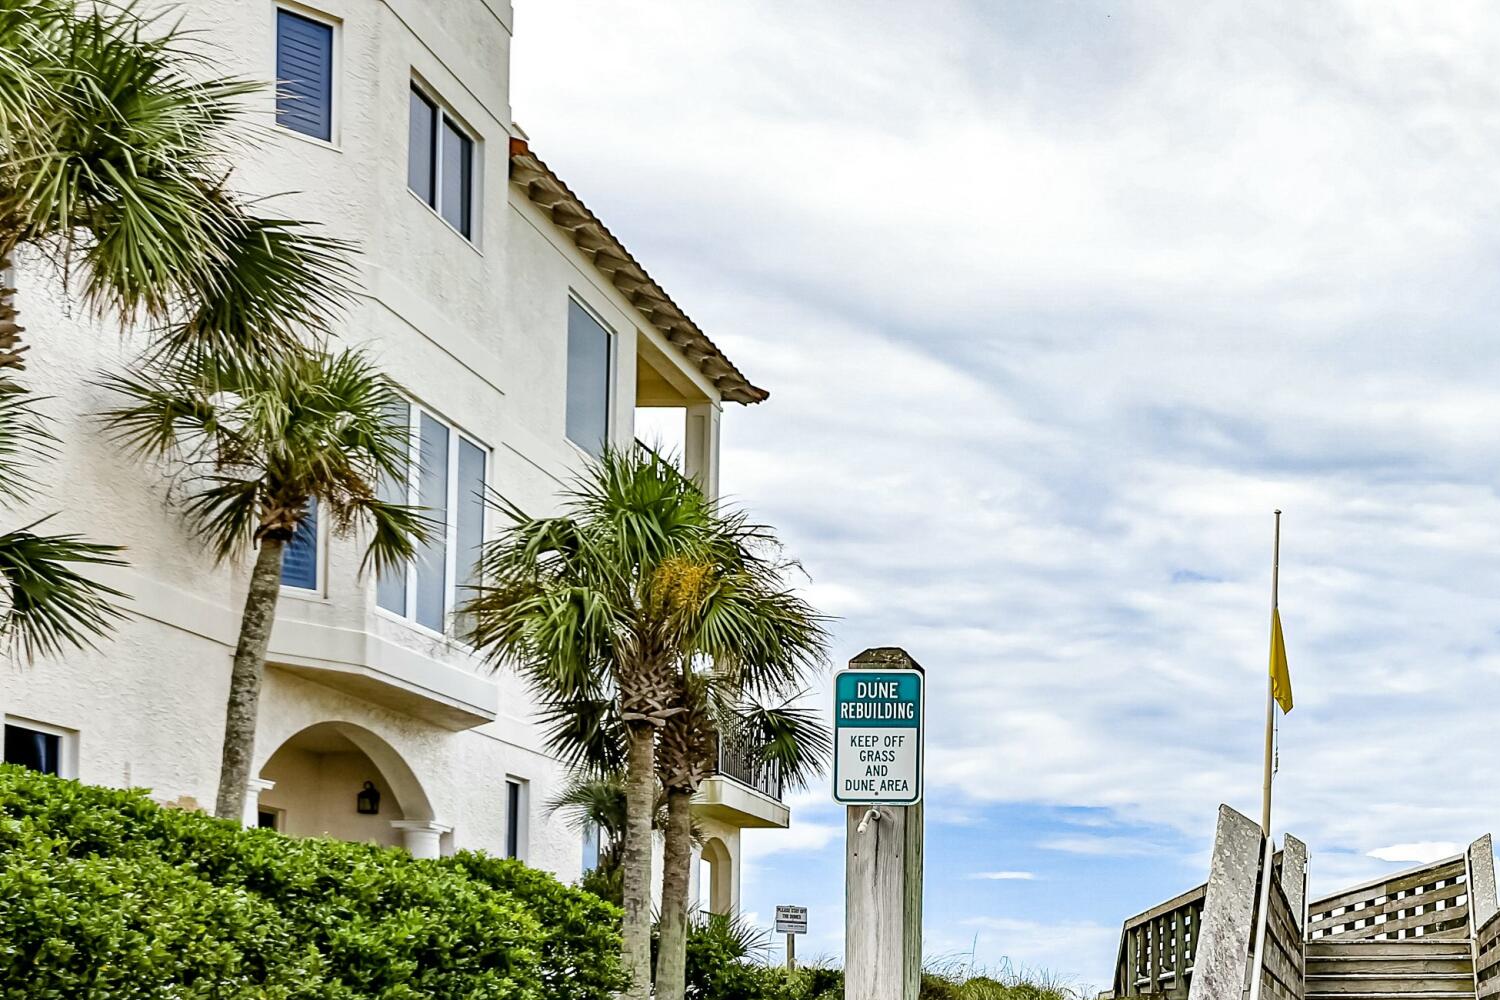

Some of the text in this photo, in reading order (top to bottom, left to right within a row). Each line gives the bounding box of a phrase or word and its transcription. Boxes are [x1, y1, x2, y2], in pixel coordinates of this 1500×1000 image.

[857, 682, 899, 699] DUNE
[840, 702, 914, 719] REBUILDING
[850, 735, 905, 748] KEEP OFF
[859, 750, 896, 762] GRASS
[865, 765, 888, 777] AND
[845, 779, 909, 791] DUNE AREA
